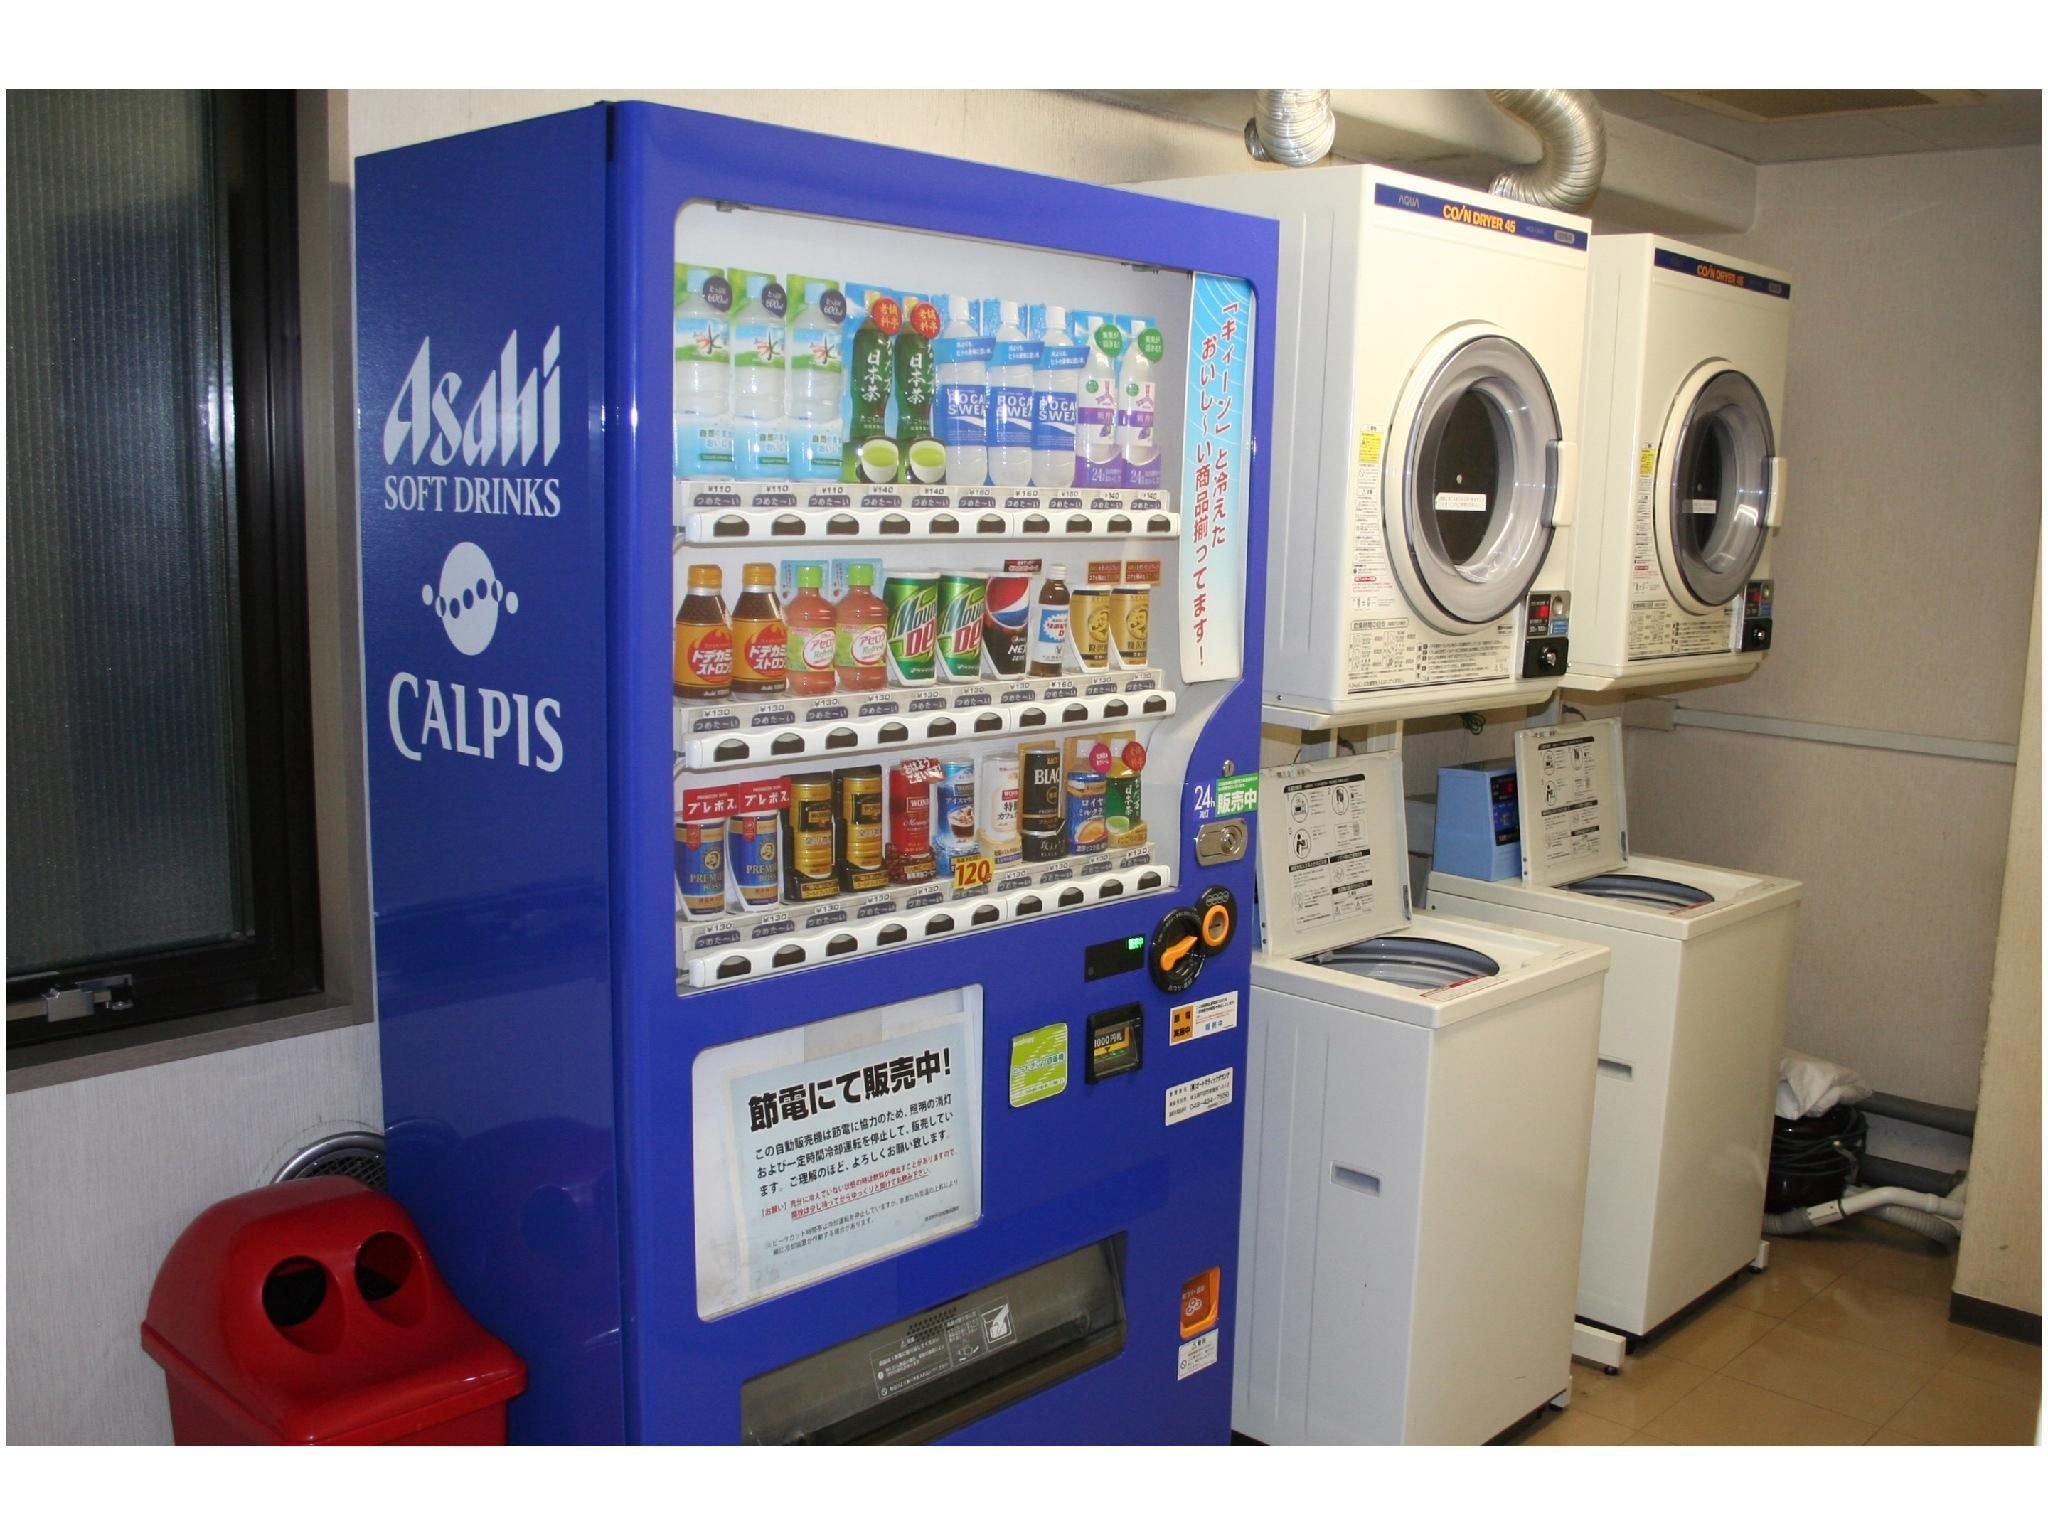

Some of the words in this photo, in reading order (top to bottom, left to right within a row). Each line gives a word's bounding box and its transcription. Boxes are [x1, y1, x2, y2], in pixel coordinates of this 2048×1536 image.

[1473, 212, 1504, 231] DRYER
[1505, 220, 1516, 233] 45
[383, 325, 560, 466] Asahi
[862, 350, 882, 402] 日本茶
[907, 352, 927, 406] 日本茶
[384, 475, 448, 511] SOFT
[454, 477, 560, 517] DRINKS
[389, 671, 563, 772] CALPIS
[704, 708, 731, 716] ¥130
[760, 704, 785, 713] ¥130
[1217, 788, 1258, 815] 販売中
[957, 860, 990, 886] 120
[749, 1047, 951, 1132] 節電にて販売中!
